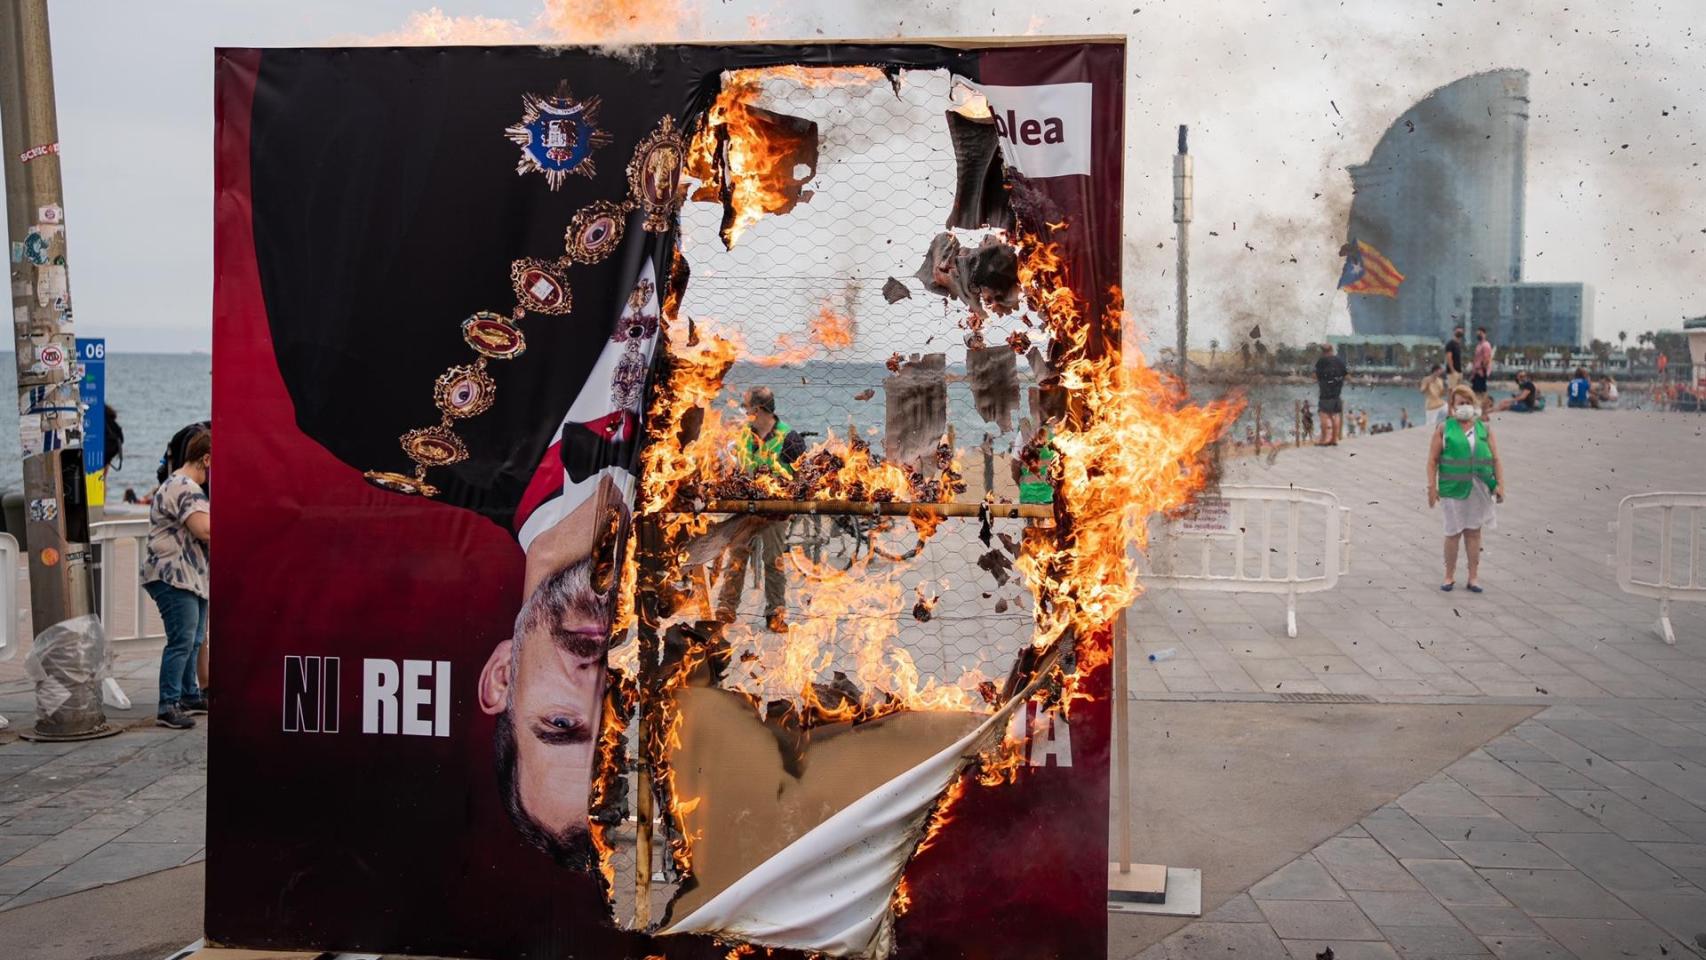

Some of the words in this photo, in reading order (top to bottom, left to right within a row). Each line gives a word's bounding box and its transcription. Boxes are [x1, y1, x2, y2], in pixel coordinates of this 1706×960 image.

[85, 343, 104, 359] 06
[282, 655, 341, 734] NI
[362, 658, 452, 737] REI
